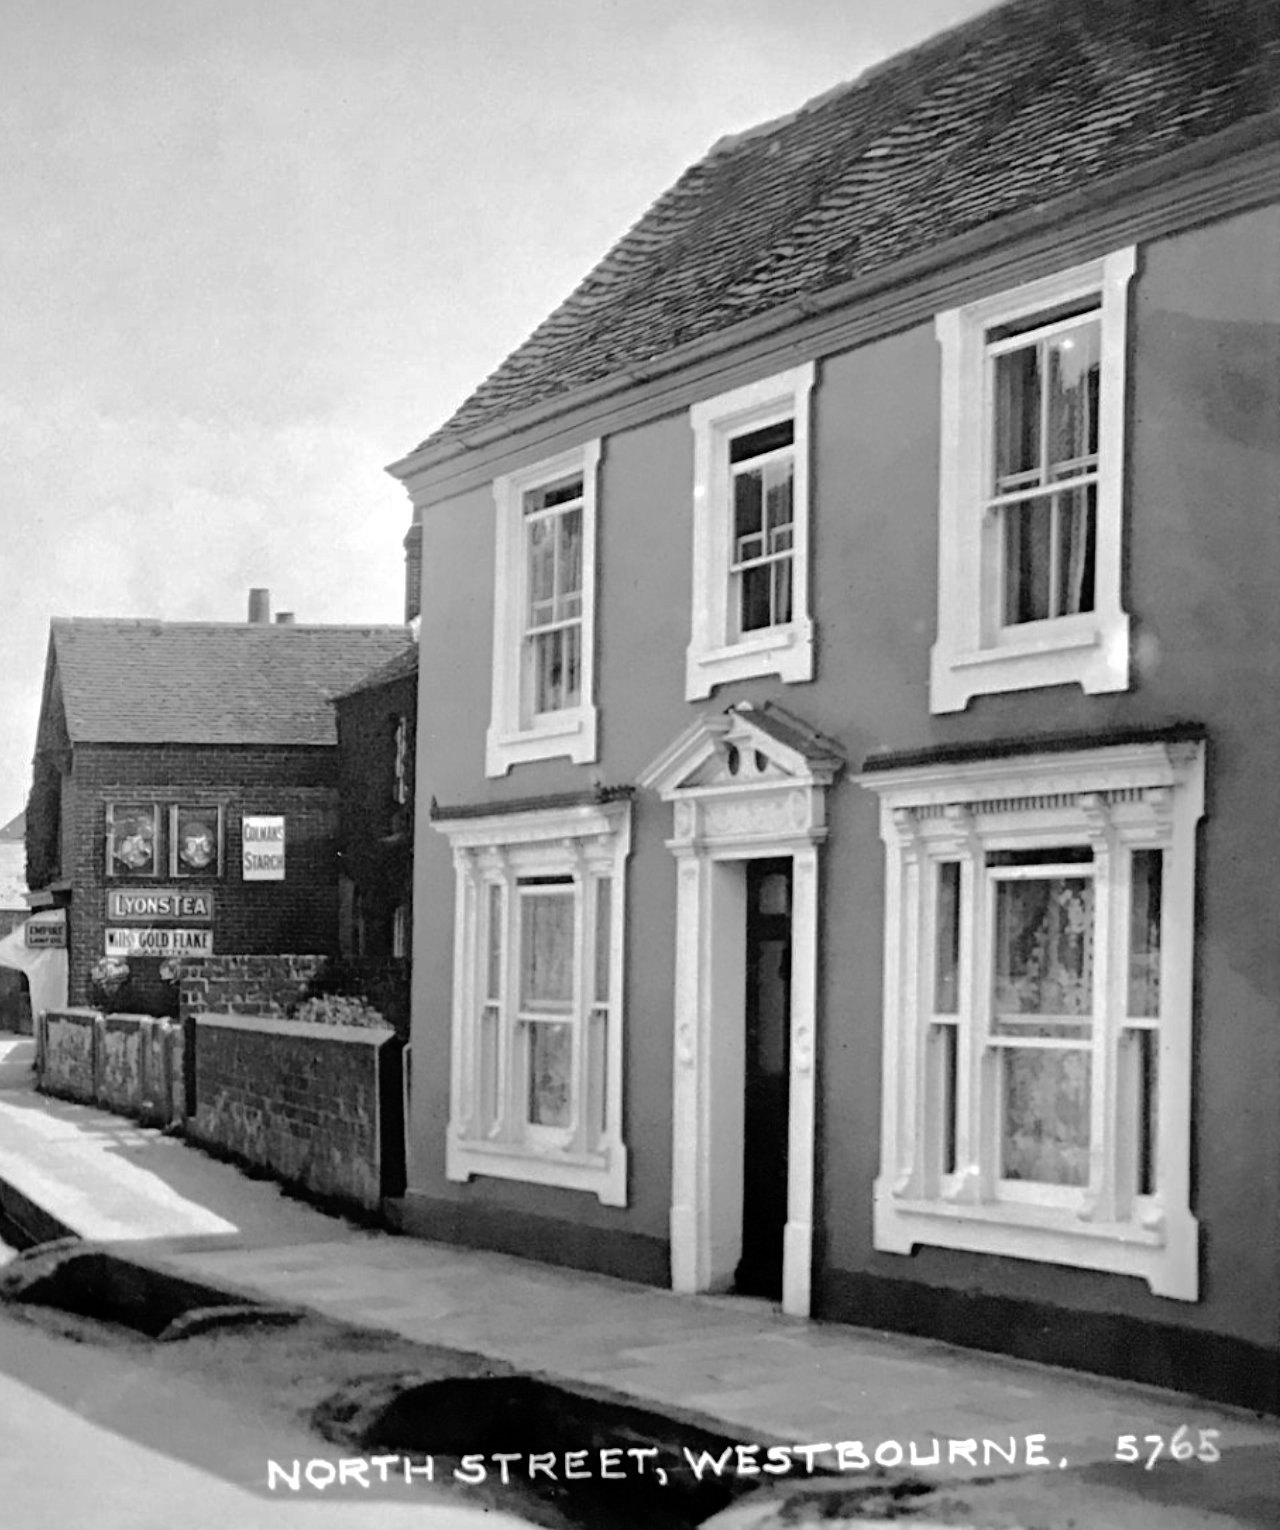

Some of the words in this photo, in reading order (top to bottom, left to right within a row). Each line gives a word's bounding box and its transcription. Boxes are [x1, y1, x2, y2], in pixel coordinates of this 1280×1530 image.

[173, 896, 206, 916] TEA
[139, 932, 169, 948] GOLD
[173, 932, 207, 949] FLAKE
